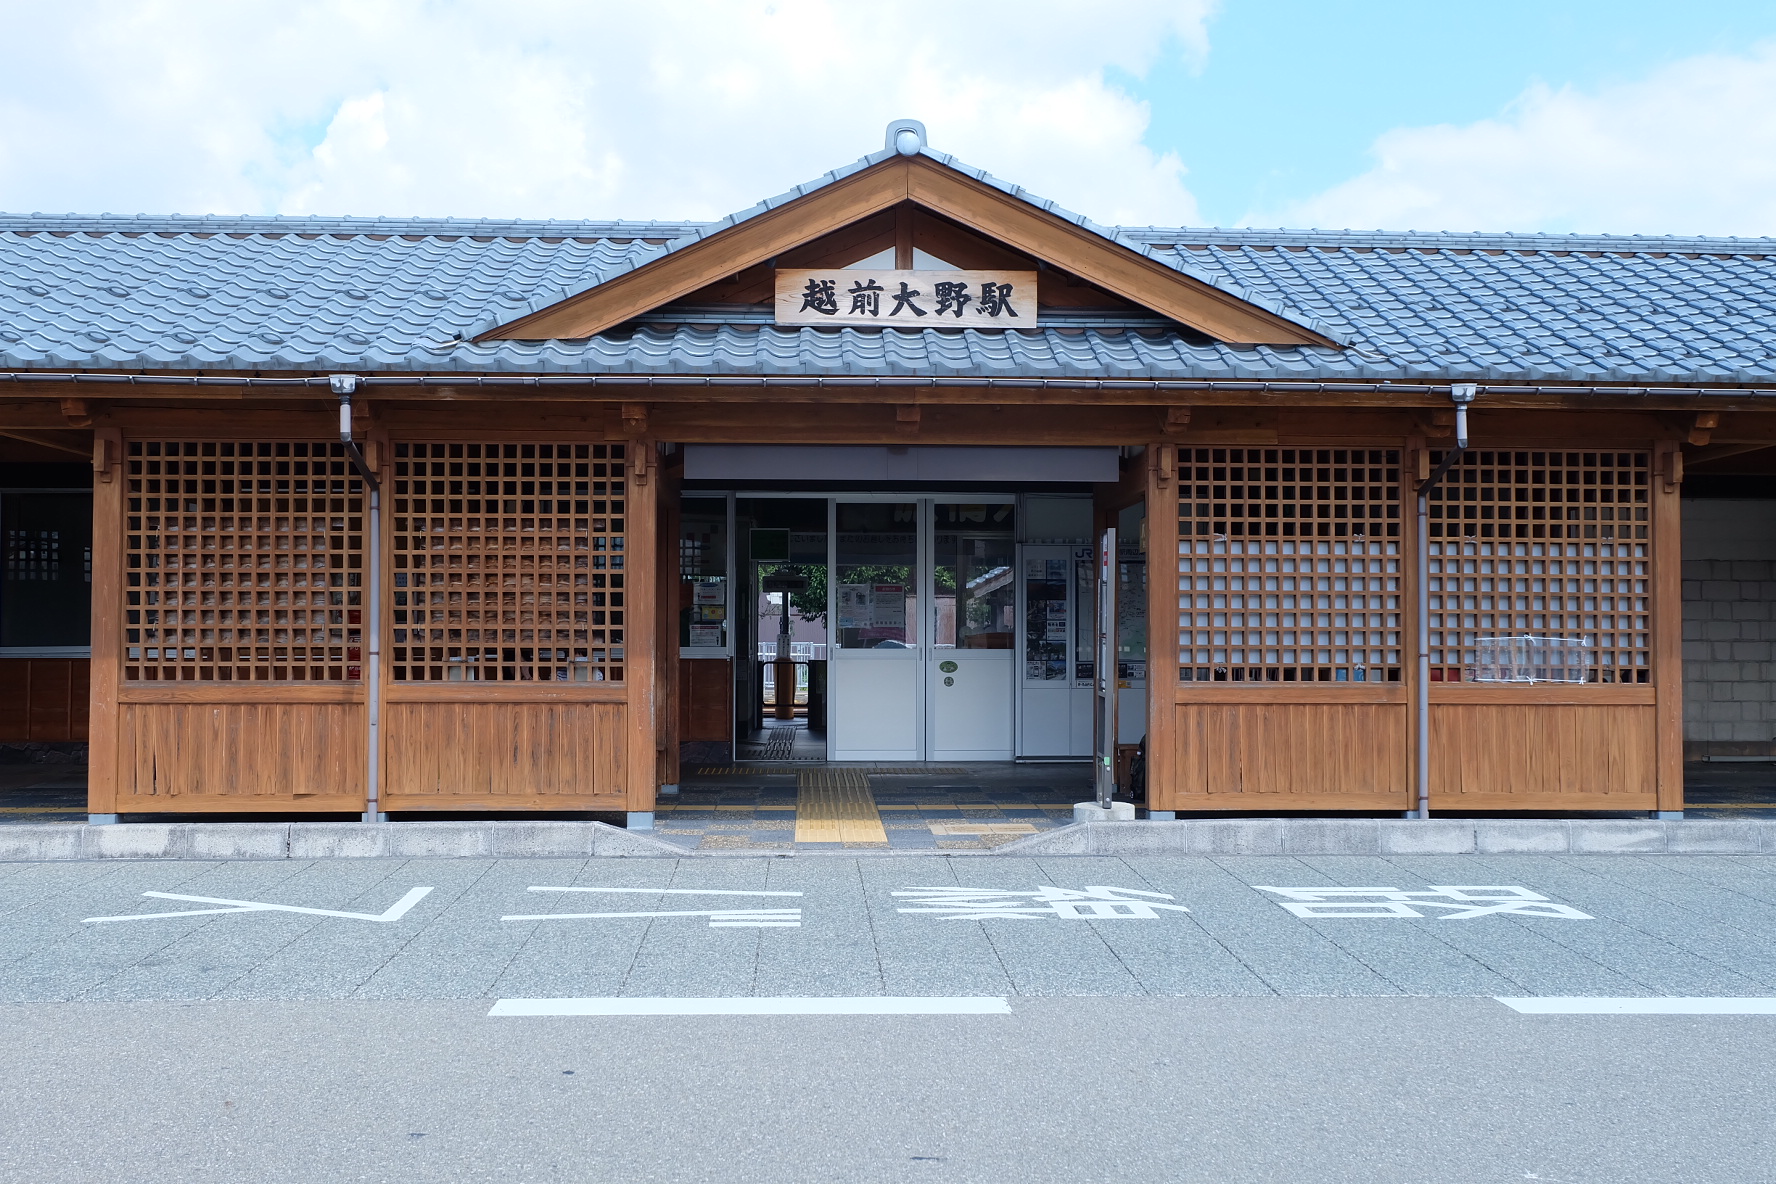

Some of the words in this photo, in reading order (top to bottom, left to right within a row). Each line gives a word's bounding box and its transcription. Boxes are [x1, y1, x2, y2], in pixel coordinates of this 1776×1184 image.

[798, 278, 1019, 318] 越前大野駅
[1075, 548, 1092, 559] JR
